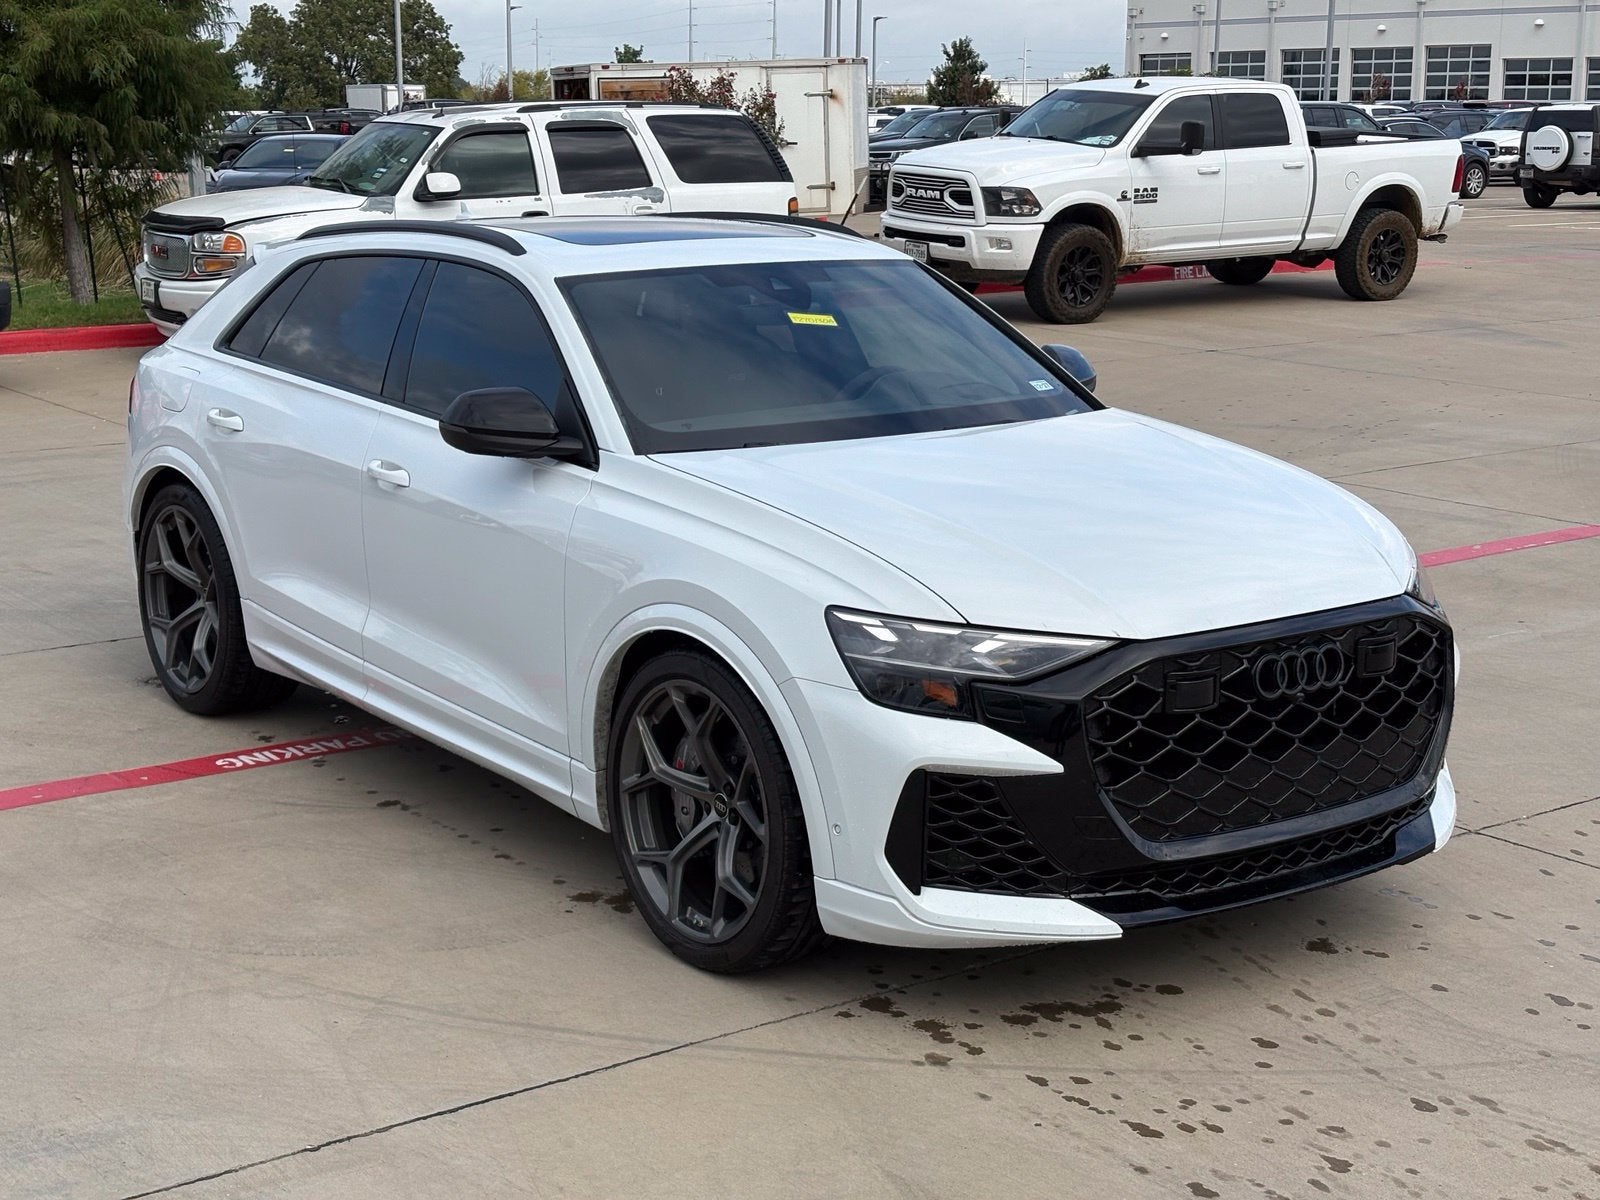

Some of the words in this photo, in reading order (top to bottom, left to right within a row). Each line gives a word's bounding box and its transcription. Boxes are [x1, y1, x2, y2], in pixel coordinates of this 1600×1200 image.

[906, 187, 941, 199] RAM
[1174, 265, 1195, 280] FIRE
[215, 735, 371, 769] PARKING
